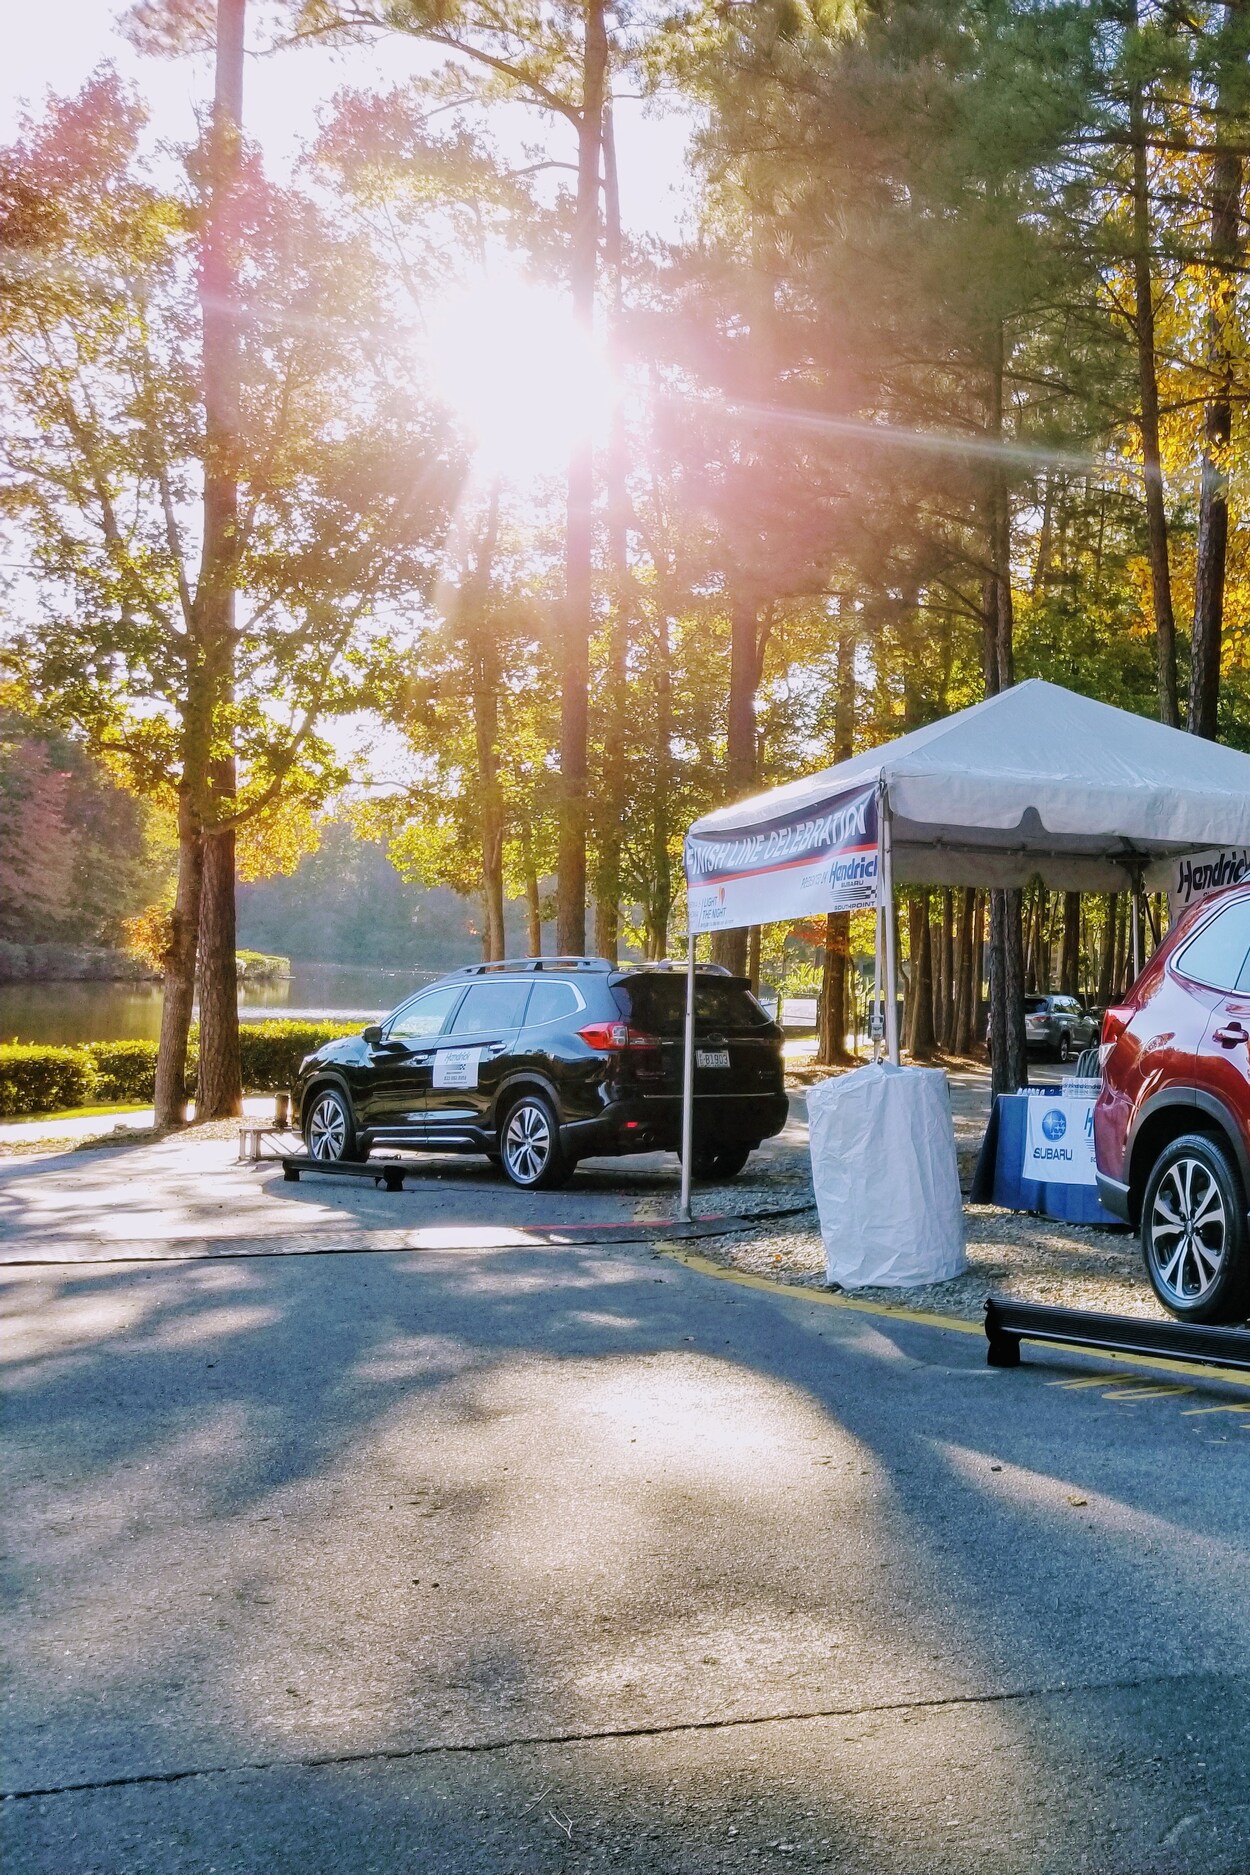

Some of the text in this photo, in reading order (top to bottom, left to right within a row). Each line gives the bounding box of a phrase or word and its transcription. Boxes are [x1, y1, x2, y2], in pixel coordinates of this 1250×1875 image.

[687, 804, 868, 875] FINISH LINE CELEBRATION
[841, 880, 864, 888] SUBARU
[834, 901, 876, 911] SOUTHPOINT
[1033, 1147, 1073, 1161] SUBARU
[1044, 1373, 1199, 1400] NO
